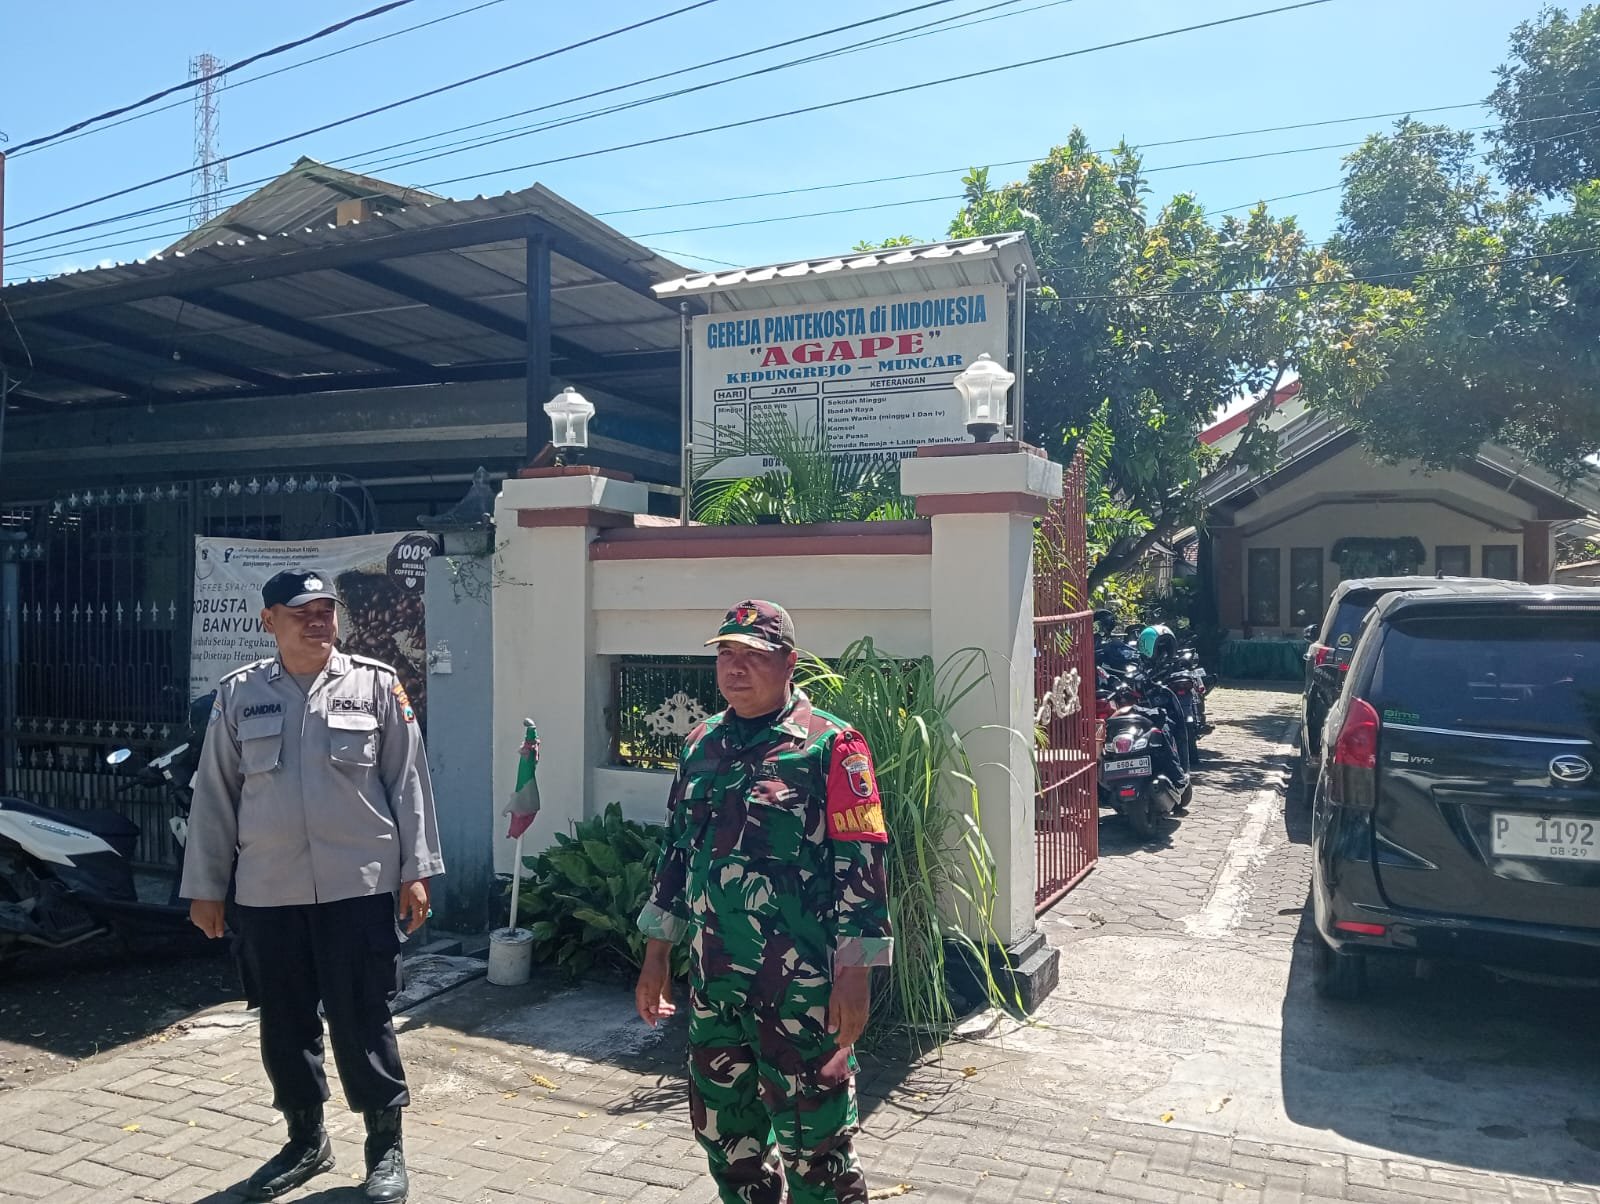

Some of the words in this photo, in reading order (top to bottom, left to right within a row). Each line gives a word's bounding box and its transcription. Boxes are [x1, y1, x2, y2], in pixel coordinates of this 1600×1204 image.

[707, 318, 761, 349] GEREJA
[764, 308, 866, 343] PANTEKOSTA
[870, 305, 887, 334] di
[891, 294, 987, 331] INDONESIA
[726, 364, 852, 384] KEDUNGREJO
[878, 354, 962, 372] MUNCAR
[870, 376, 926, 388] KETERANGAN
[718, 390, 743, 399] HARI
[771, 386, 798, 395] JAM
[879, 413, 910, 421] (minggu
[398, 544, 432, 560] 100%
[194, 598, 248, 614] OBUSTA
[213, 636, 236, 648] Setiap
[204, 650, 232, 662] Disetiap
[243, 703, 282, 718] CANDRA
[1496, 818, 1509, 840] P
[1535, 820, 1594, 846] 1192
